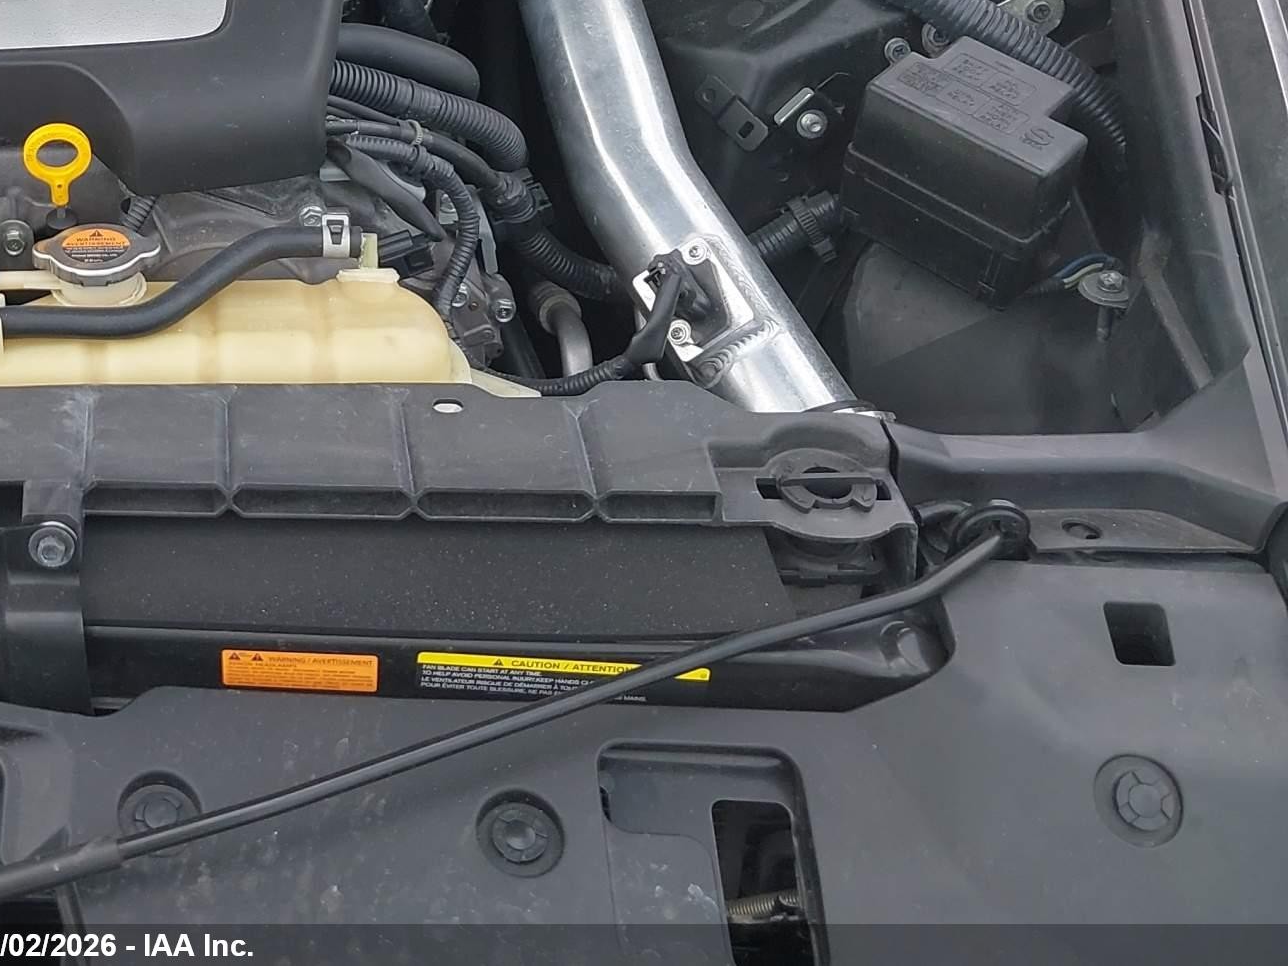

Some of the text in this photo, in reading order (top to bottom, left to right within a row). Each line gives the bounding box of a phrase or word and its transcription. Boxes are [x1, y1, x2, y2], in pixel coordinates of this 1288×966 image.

[268, 656, 306, 664] WARNING
[511, 660, 560, 670] CAUTION
[432, 677, 474, 685] VENTILATEUR
[474, 673, 510, 681] PERSONAL
